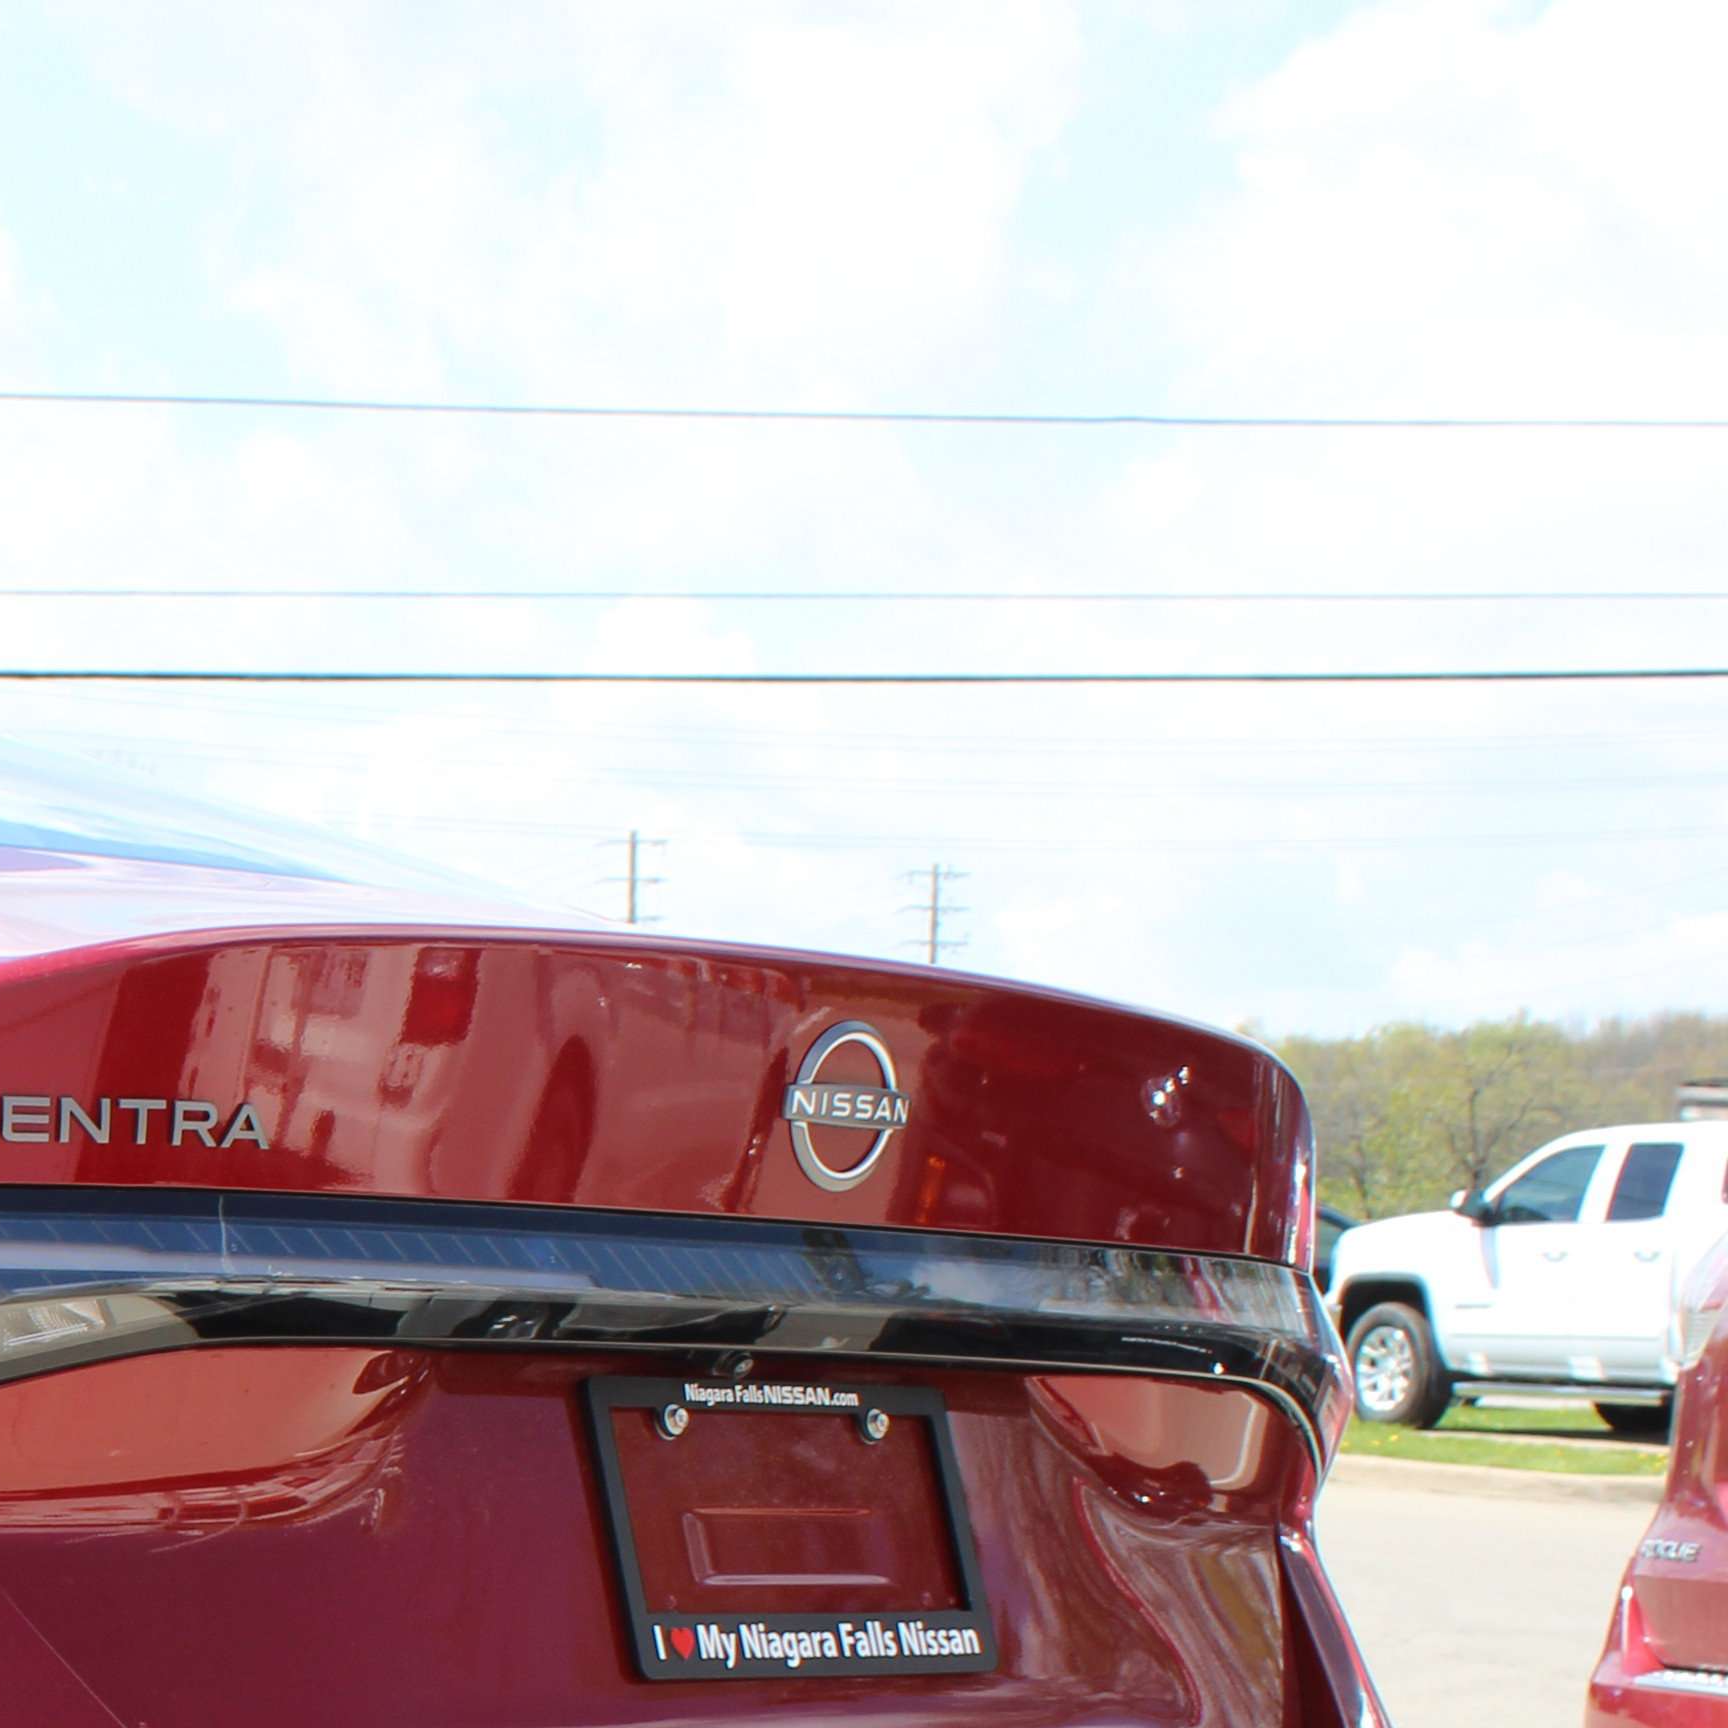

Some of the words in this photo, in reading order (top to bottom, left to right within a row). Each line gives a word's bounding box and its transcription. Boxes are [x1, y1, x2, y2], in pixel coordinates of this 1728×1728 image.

[791, 1090, 910, 1124] NISSAN
[652, 1624, 667, 1660] I
[695, 1623, 737, 1669] My
[738, 1622, 839, 1668] Niagara
[837, 1620, 898, 1658] Falls
[897, 1620, 981, 1656] Nissan
